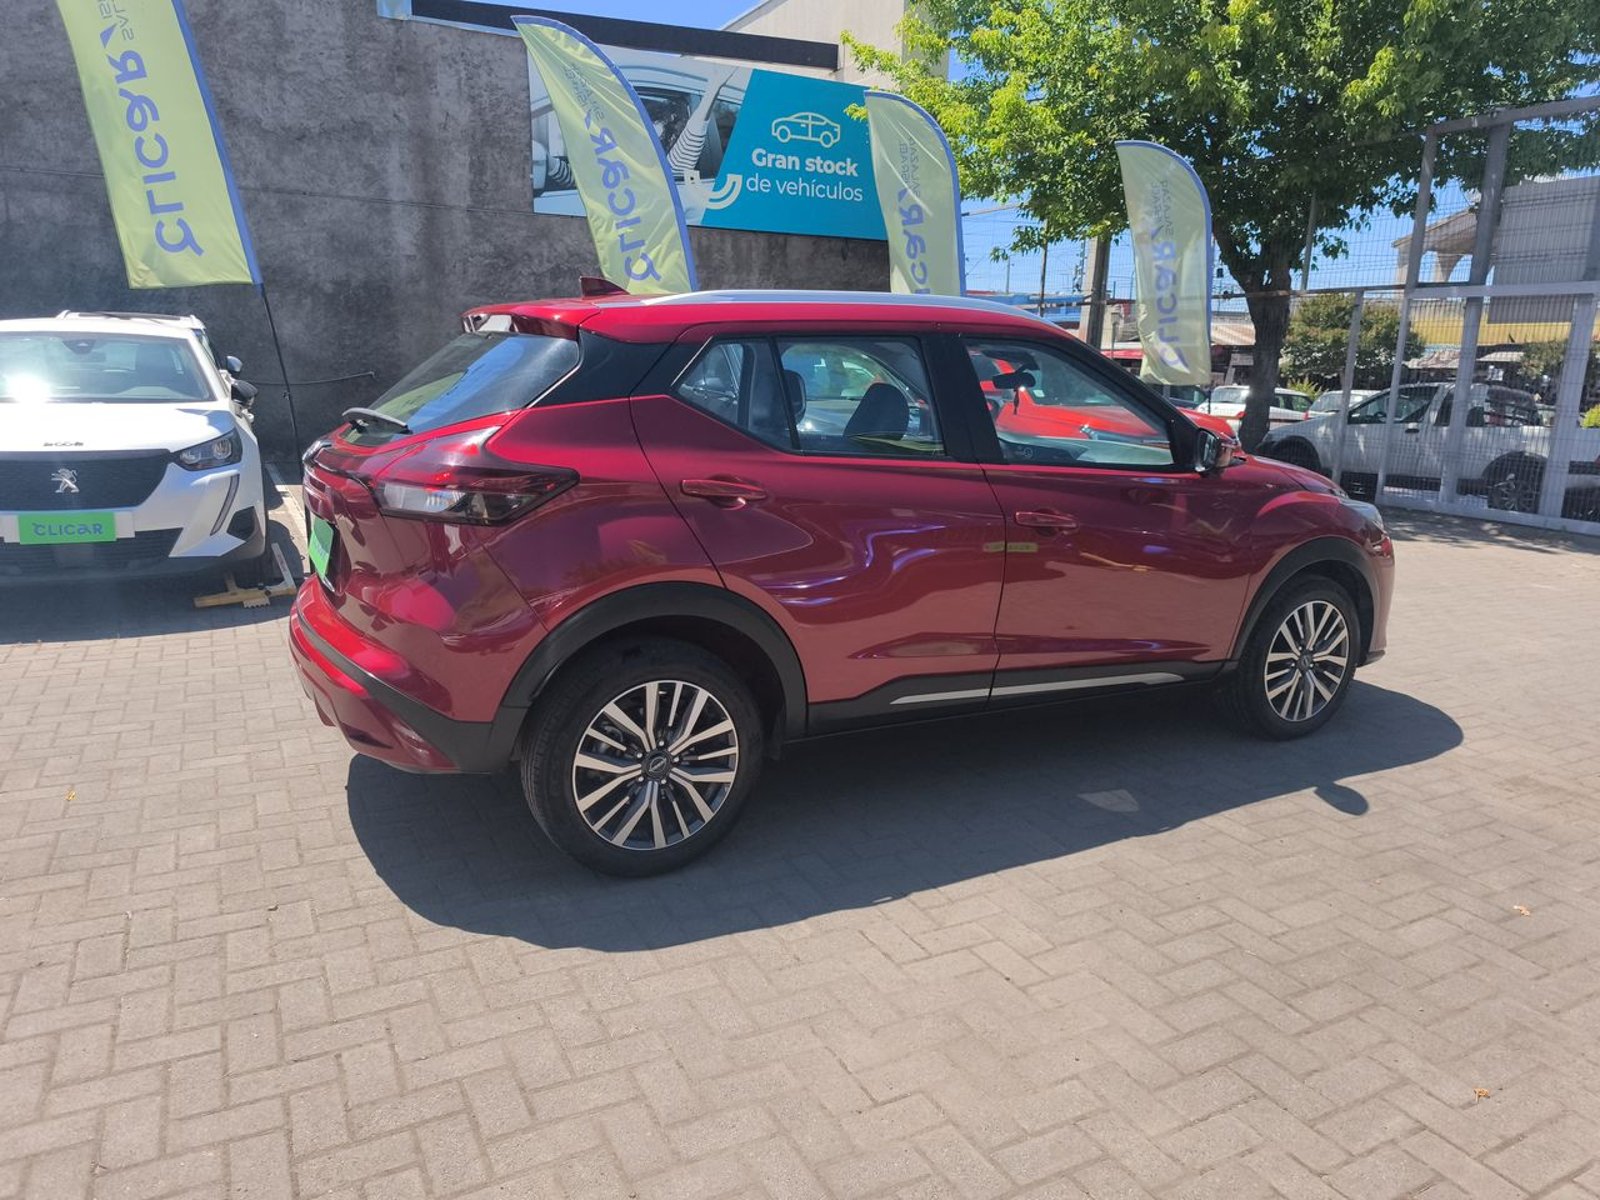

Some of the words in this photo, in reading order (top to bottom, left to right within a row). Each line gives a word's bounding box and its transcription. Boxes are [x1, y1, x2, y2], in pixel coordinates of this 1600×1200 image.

[751, 148, 800, 171] Gran
[805, 156, 858, 177] stock
[746, 173, 771, 193] de
[775, 177, 863, 202] vehículos
